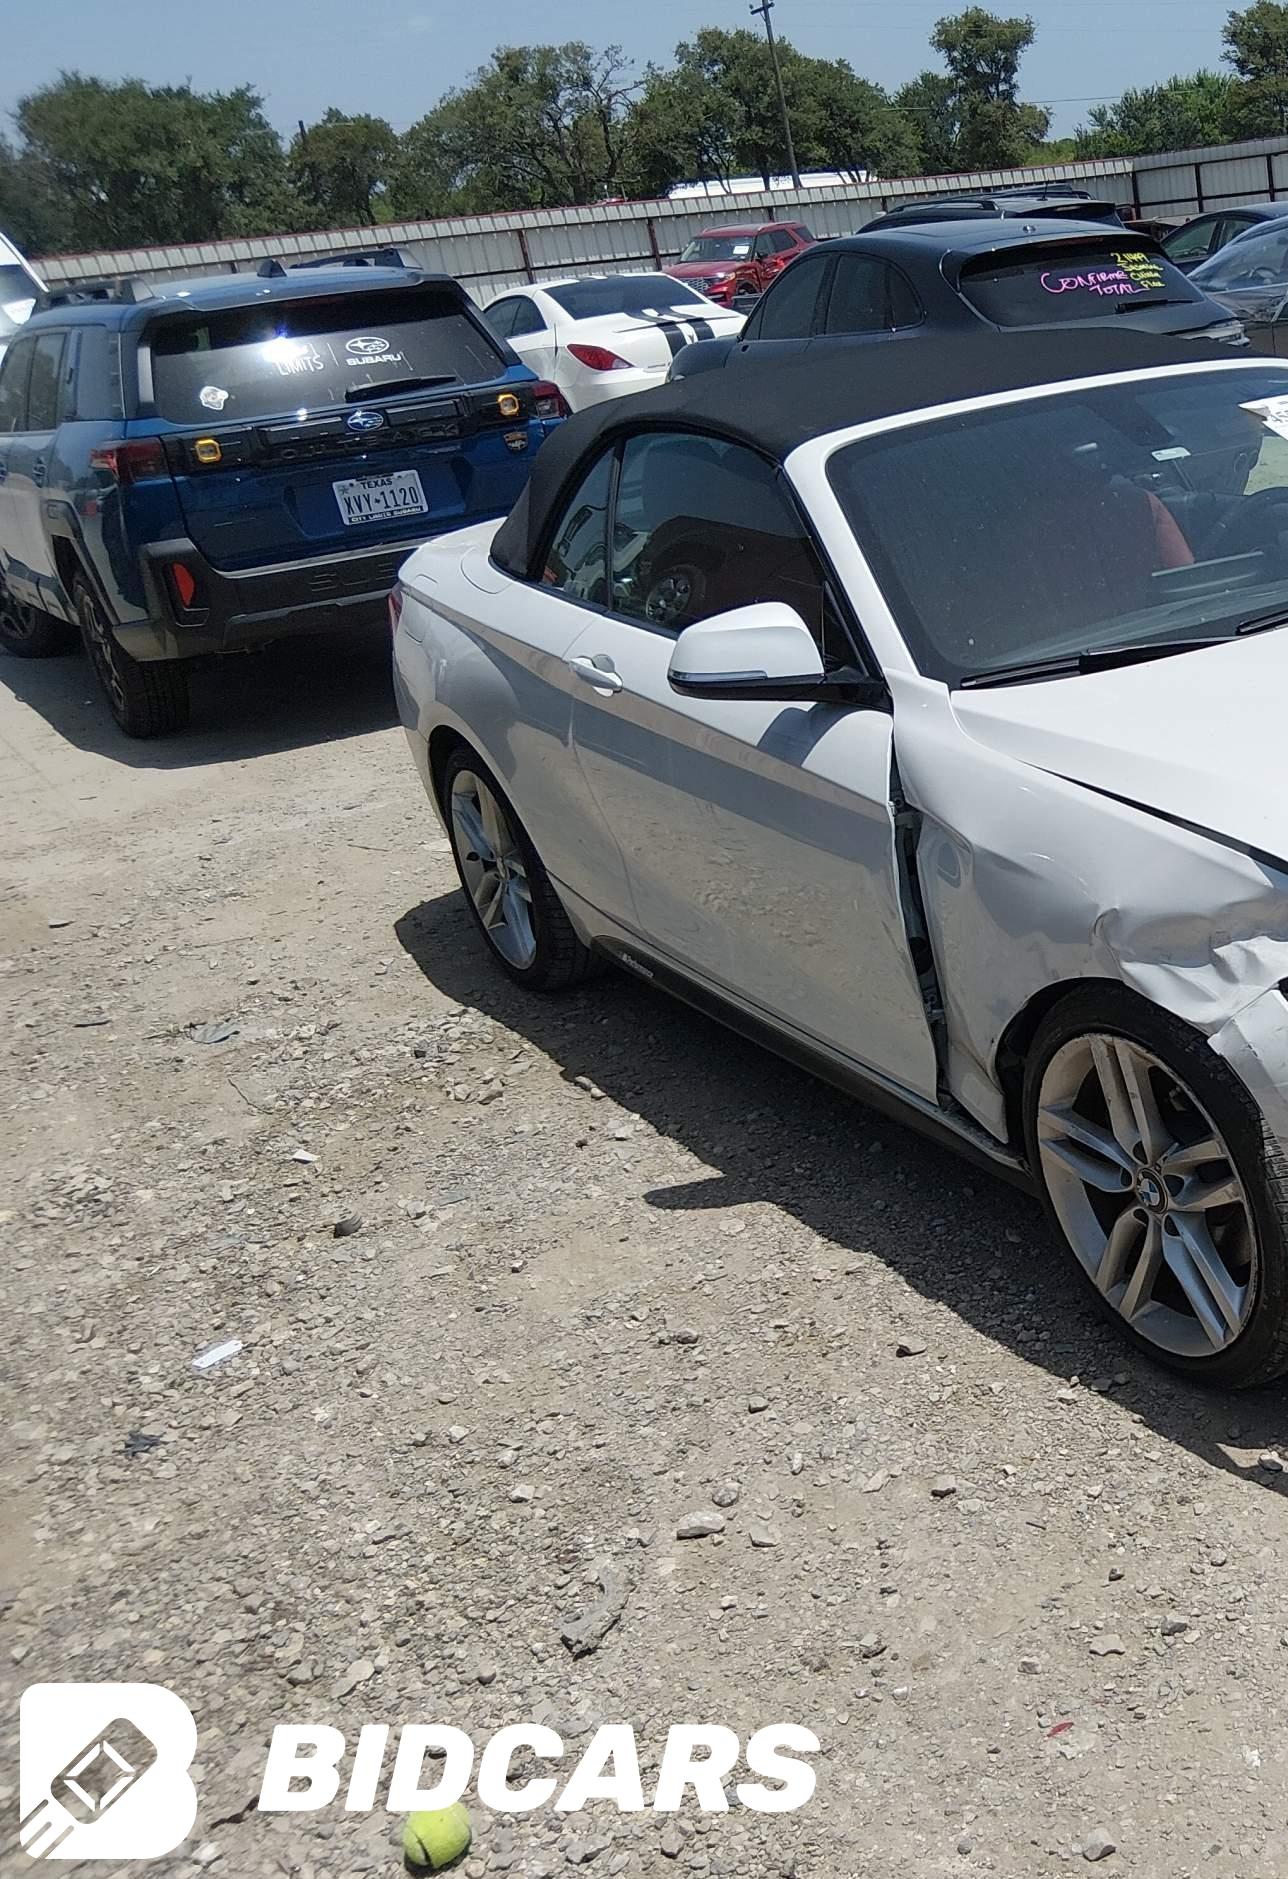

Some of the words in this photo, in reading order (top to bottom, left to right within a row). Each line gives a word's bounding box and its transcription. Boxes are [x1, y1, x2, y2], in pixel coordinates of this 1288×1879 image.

[276, 354, 324, 376] LIMITS
[346, 353, 402, 366] SUBARU
[361, 478, 393, 490] TEXAS
